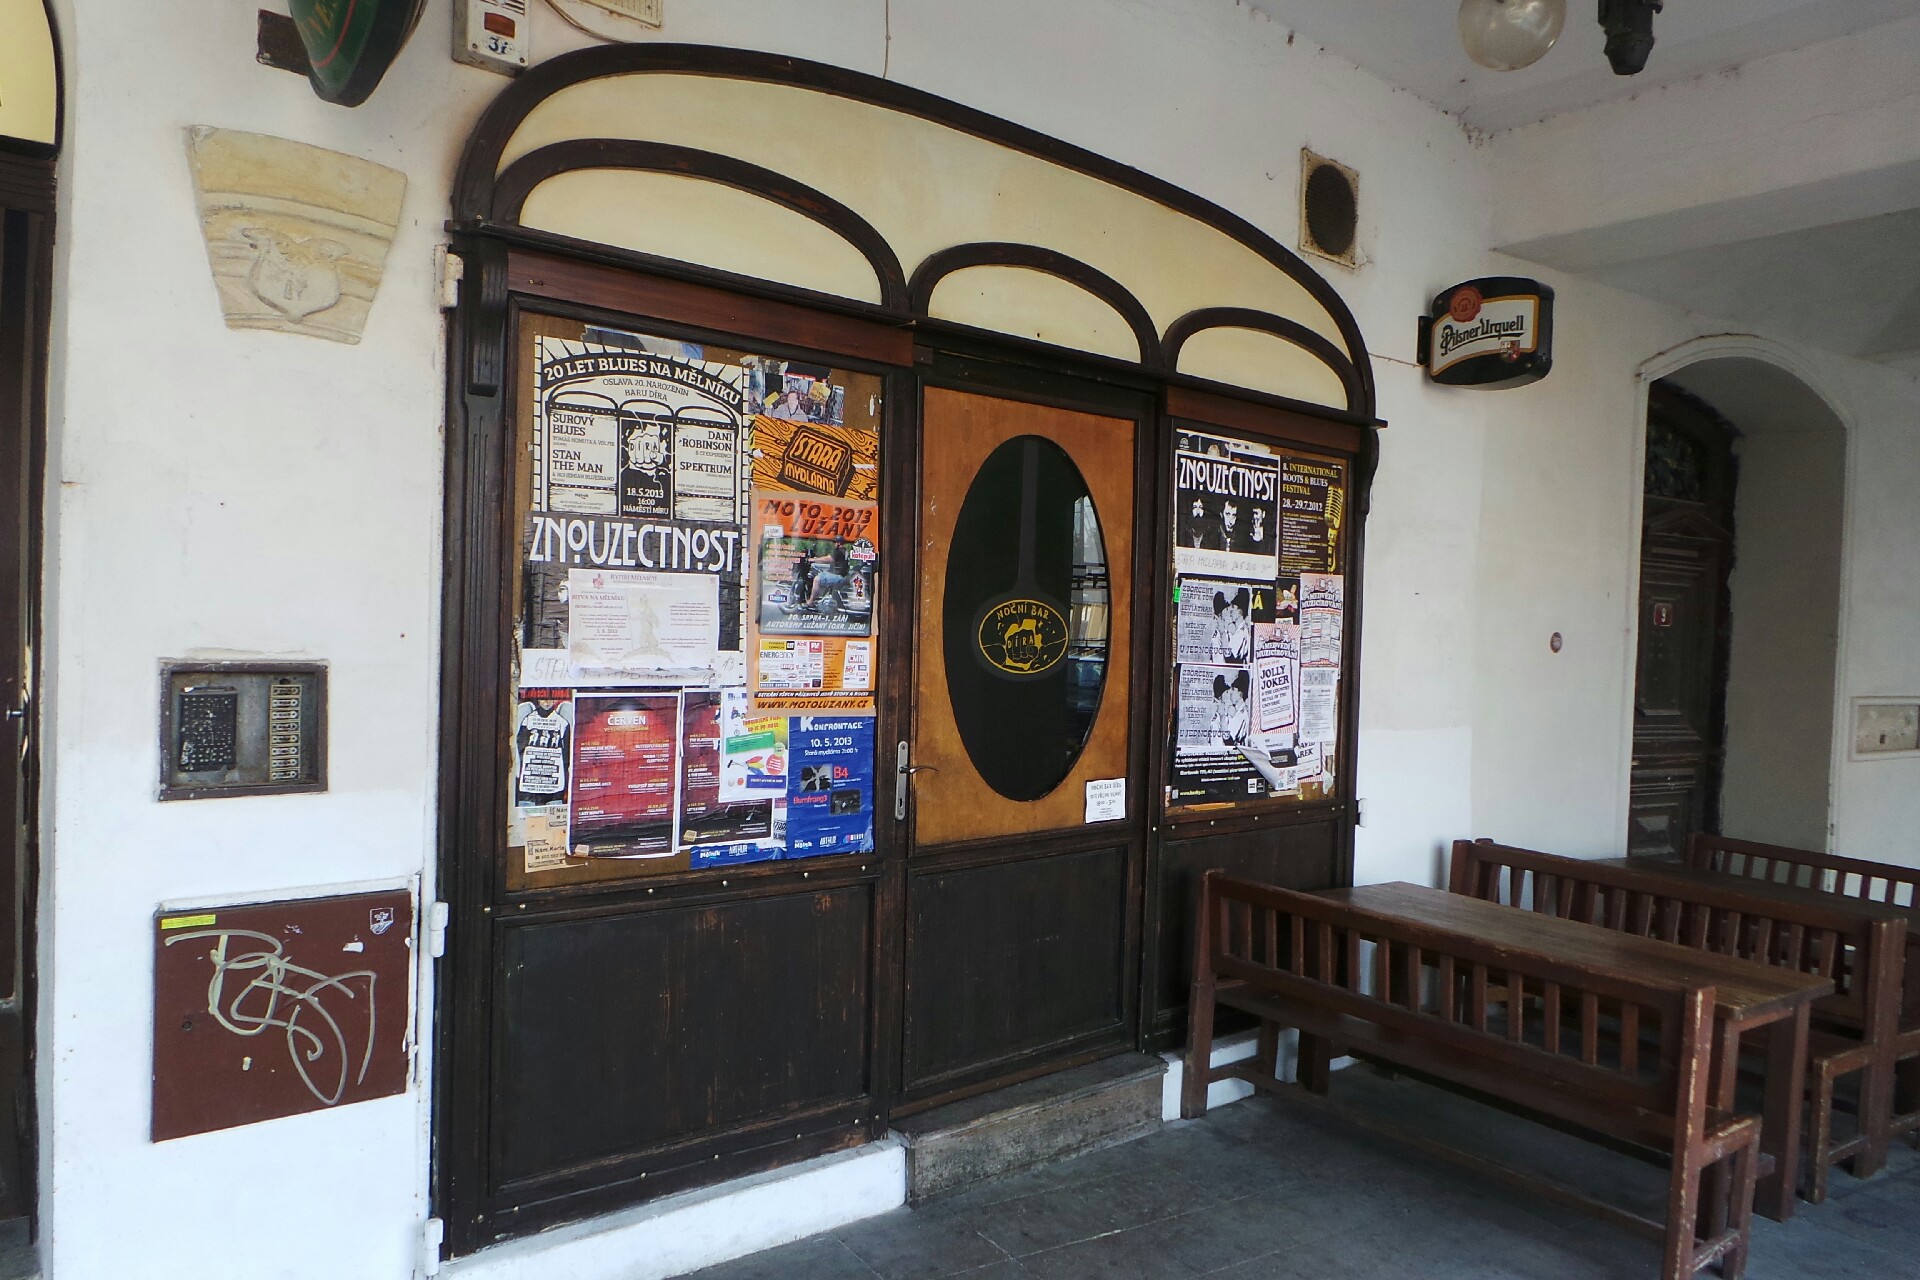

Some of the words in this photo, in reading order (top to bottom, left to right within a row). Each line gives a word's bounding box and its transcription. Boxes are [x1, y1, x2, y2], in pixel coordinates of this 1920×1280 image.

[1440, 324, 1481, 356] Pilsner
[1480, 315, 1525, 340] Urquell
[544, 365, 564, 380] 20
[565, 359, 594, 376] LET
[598, 358, 647, 373] BLUES
[650, 362, 672, 378] NA
[674, 367, 740, 405] MĚLNÍKU
[602, 378, 634, 386] OSLAVA
[646, 380, 689, 396] NAROZENIN
[624, 389, 647, 397] BARU
[648, 390, 668, 401] DÍRA
[552, 412, 595, 426] SUROVÝ
[552, 424, 586, 436] BLUES
[708, 431, 732, 442] DANI
[682, 438, 732, 452] ROBINSON
[552, 450, 581, 460] STAN
[552, 460, 574, 470] THE
[577, 462, 603, 473] MAN
[680, 462, 732, 474] SPEKTRUM
[1290, 463, 1338, 479] INTERNATIONAL
[1179, 458, 1277, 502] ZNOUZECTNOST
[1283, 473, 1303, 484] ROOTS
[1304, 476, 1309, 484] &
[1310, 476, 1328, 487] BLUES
[626, 488, 664, 498] 18.5.2013
[1283, 484, 1311, 496] FESTIVAL
[764, 500, 822, 518] MOTO
[832, 507, 872, 524] 2013
[530, 516, 738, 572] ZNOUZECTNOST
[997, 602, 1028, 620] NOČNÍ
[1031, 605, 1049, 619] BAR
[1008, 636, 1034, 648] DÍRA
[1260, 665, 1286, 679] JOLLY
[1261, 675, 1289, 690] JOKER
[811, 738, 822, 748] 10.
[824, 738, 832, 747] 5.
[834, 737, 852, 746] 2013
[834, 766, 848, 779] B4
